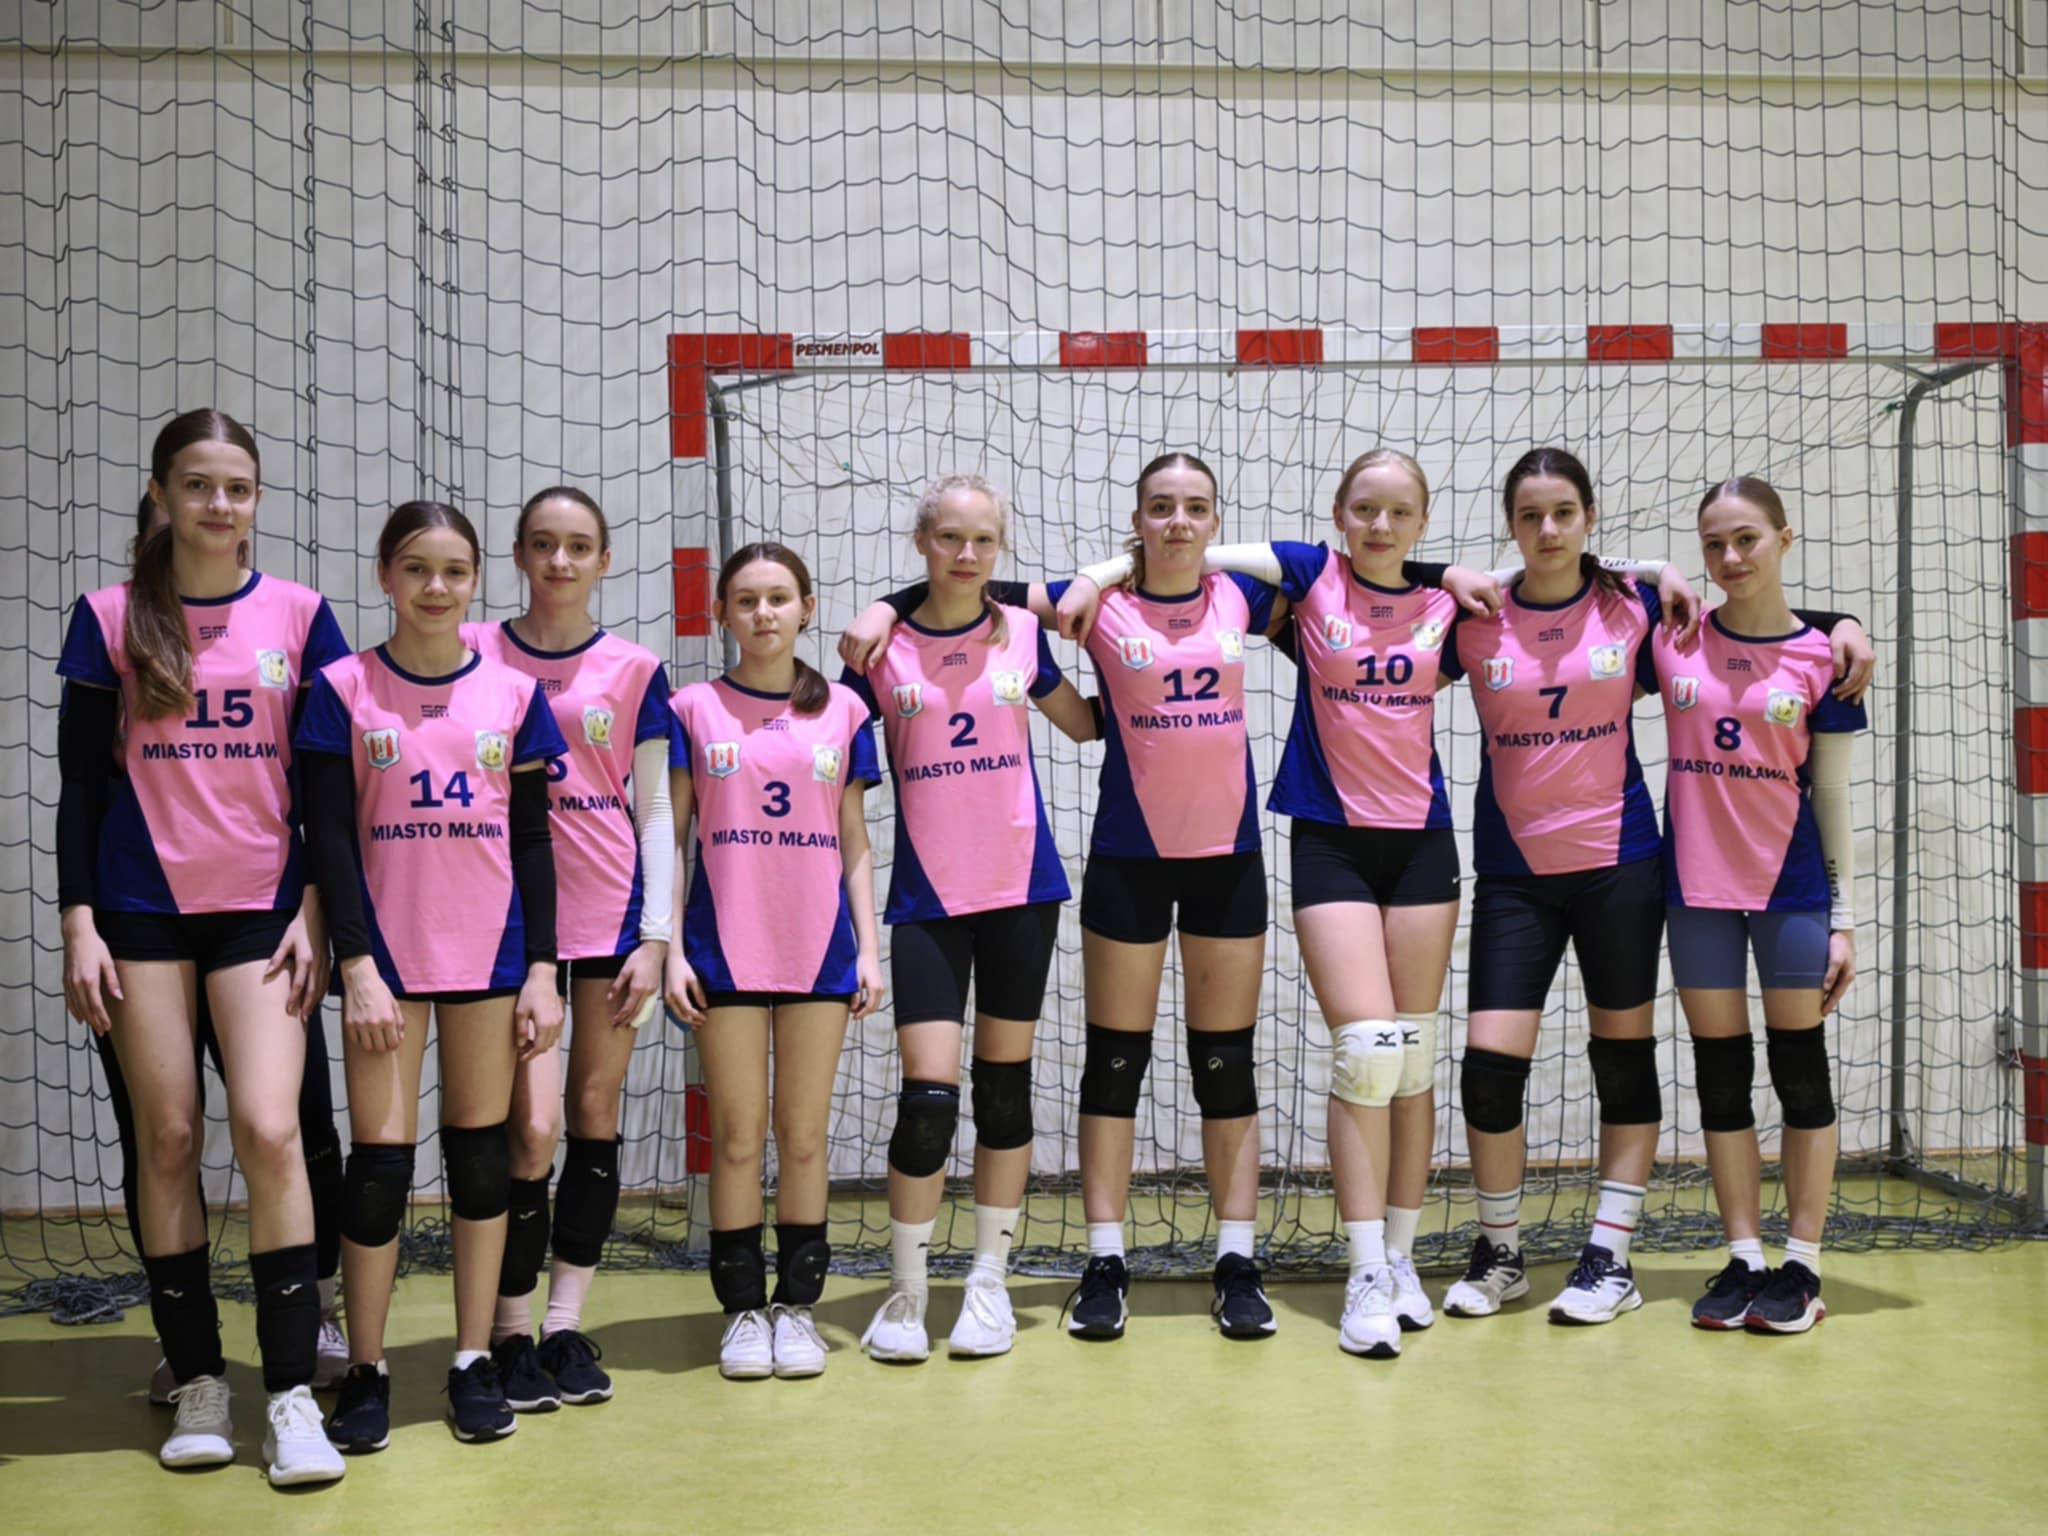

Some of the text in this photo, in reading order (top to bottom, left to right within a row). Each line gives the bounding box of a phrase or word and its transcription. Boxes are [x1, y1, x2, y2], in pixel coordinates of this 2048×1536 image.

[795, 342, 879, 356] PESMENPOL
[1355, 654, 1414, 686] 10
[1163, 667, 1221, 703] 12
[185, 689, 254, 728] 15
[1539, 686, 1569, 719] 7
[948, 712, 979, 748] 2
[1130, 714, 1193, 729] MIASTO
[1495, 721, 1618, 748] MIASTO MŁAWA
[1714, 716, 1742, 751] 8
[142, 743, 217, 760] MIASTO
[904, 760, 966, 783] MIASTO
[1672, 758, 1724, 776] MIASTO
[408, 769, 474, 808] 14
[761, 780, 792, 818] 3
[560, 795, 621, 812] MŁAWA
[371, 822, 503, 841] MIASTO MŁAWA
[711, 829, 838, 850] MIASTO MŁAWA
